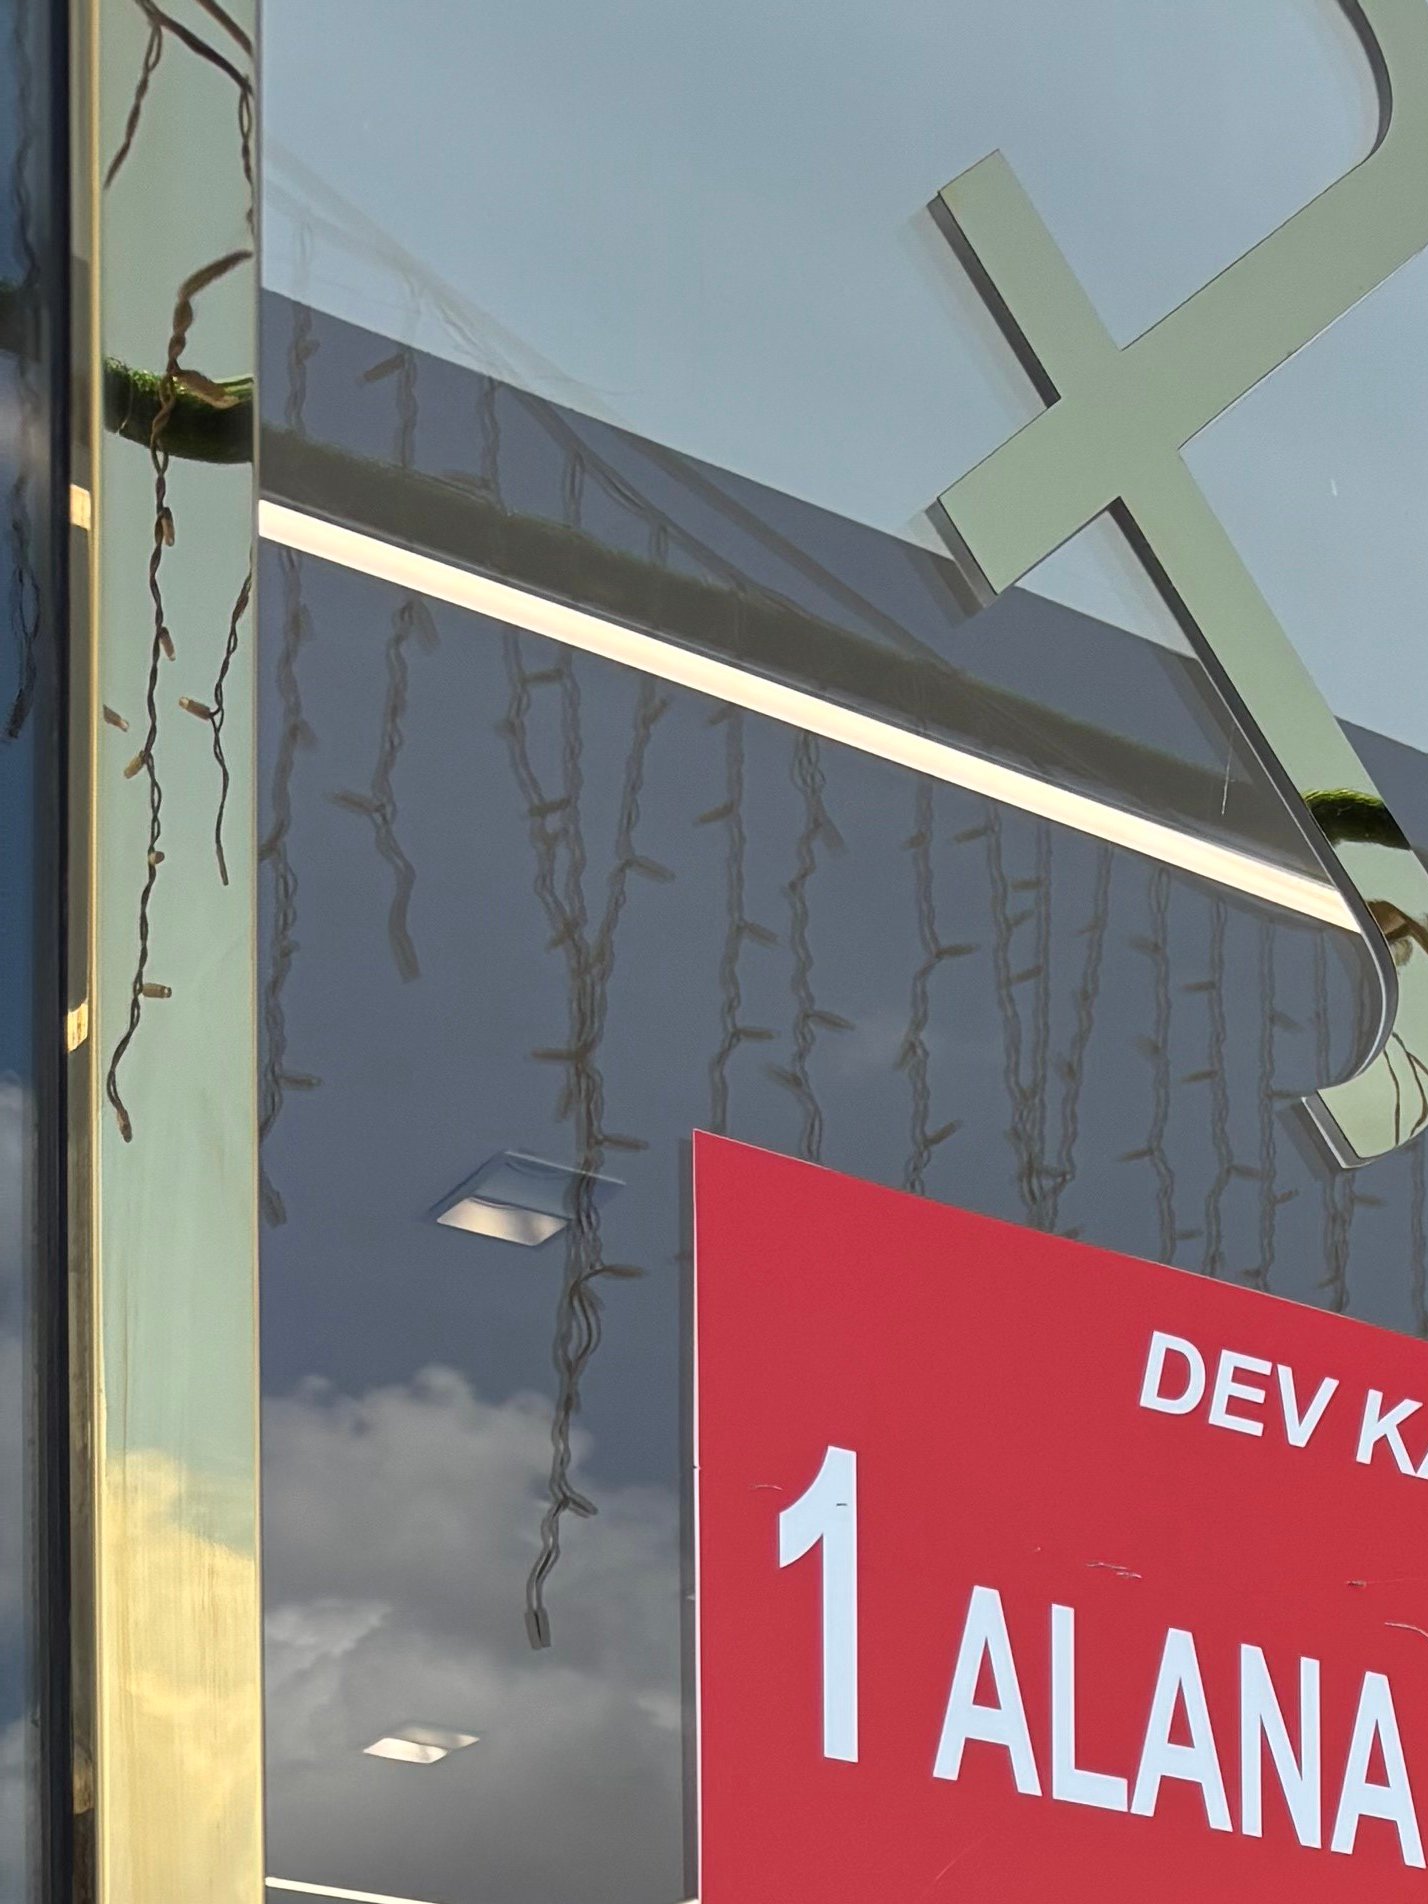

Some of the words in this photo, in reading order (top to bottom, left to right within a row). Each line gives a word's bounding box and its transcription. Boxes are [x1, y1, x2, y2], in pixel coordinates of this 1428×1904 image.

[1139, 1330, 1340, 1448] DEV
[778, 1445, 860, 1764] 1
[932, 1584, 1428, 1869] ALANA
